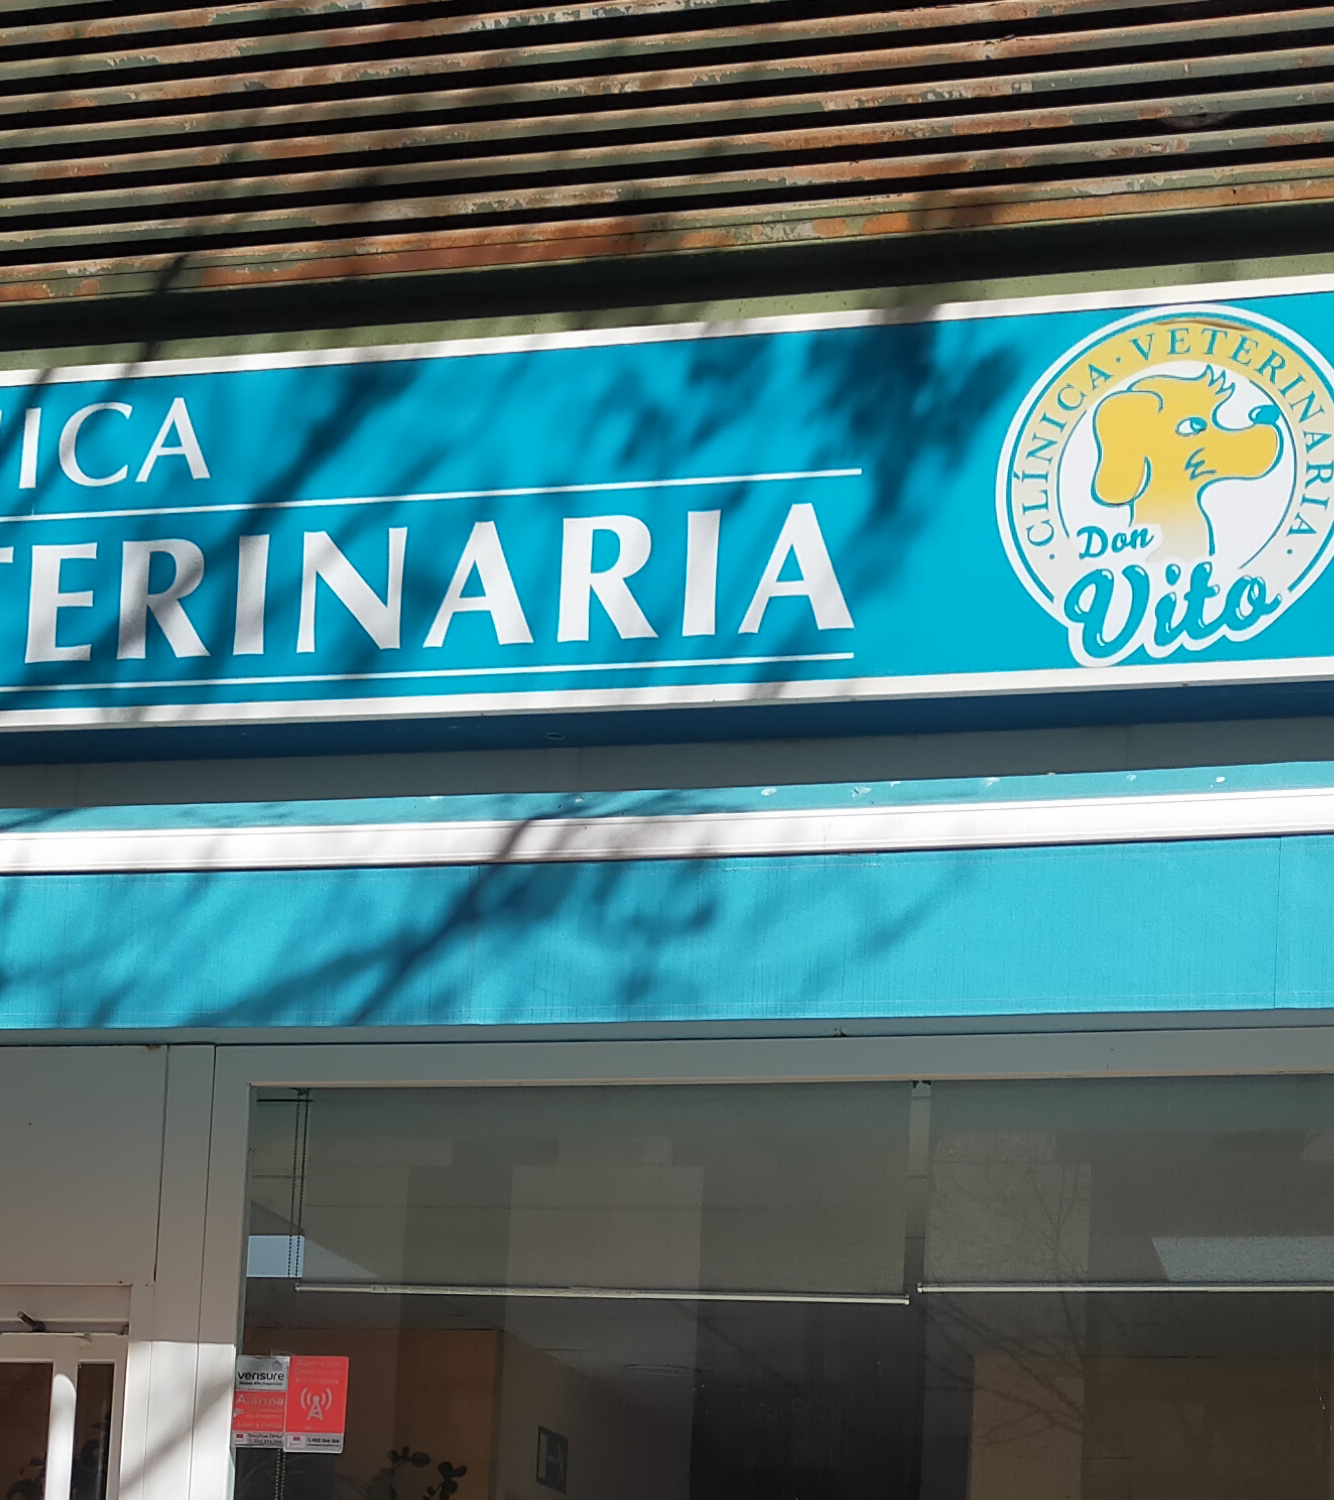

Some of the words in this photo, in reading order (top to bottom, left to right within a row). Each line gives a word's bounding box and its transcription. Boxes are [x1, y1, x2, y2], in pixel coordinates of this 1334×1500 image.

[1013, 361, 1115, 547] CLÍNICA
[1128, 327, 1334, 537] VETERINARIA
[1077, 525, 1155, 559] Don
[1064, 561, 1283, 660] Vito
[237, 1371, 285, 1382] verisure
